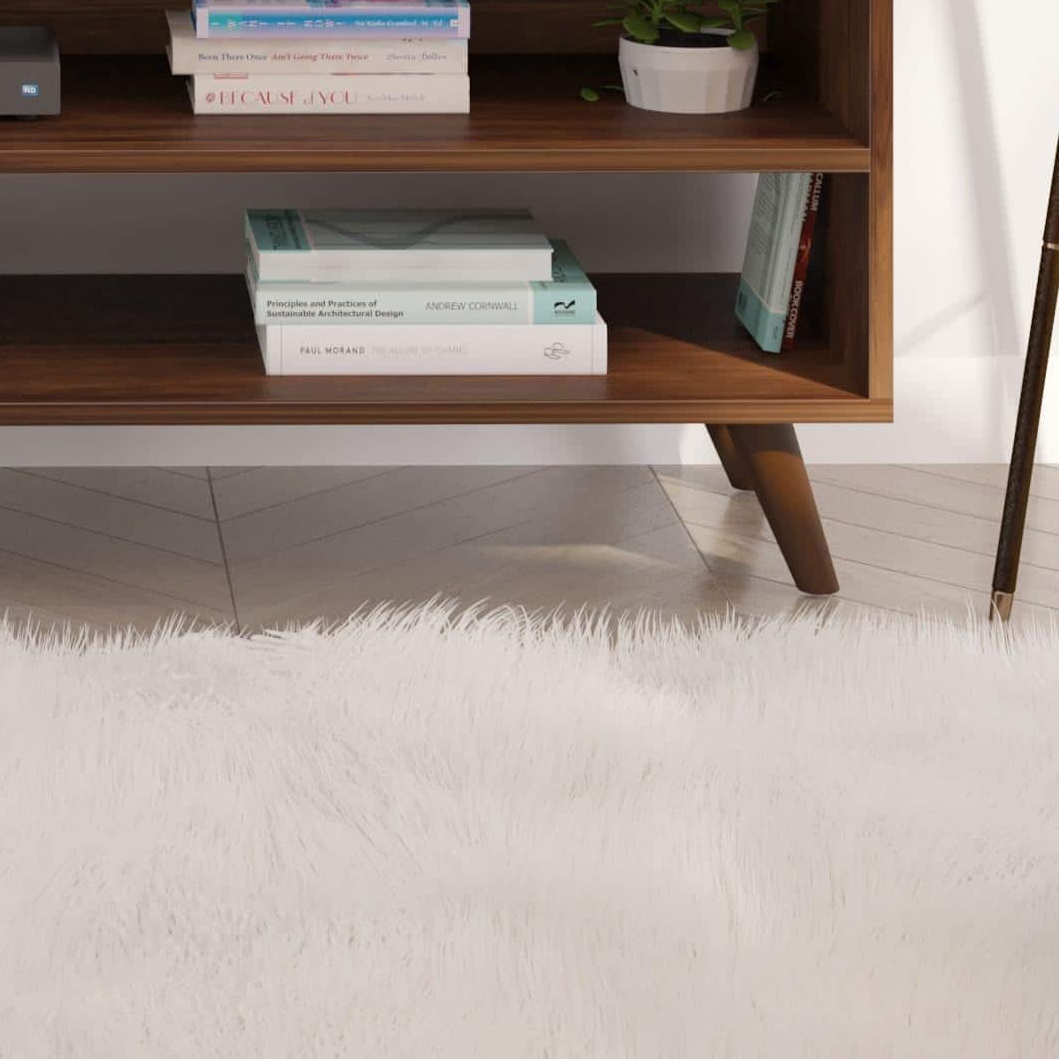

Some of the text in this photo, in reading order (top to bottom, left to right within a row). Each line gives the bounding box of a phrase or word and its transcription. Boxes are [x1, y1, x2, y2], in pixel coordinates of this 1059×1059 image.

[198, 53, 219, 61] Been
[221, 53, 244, 61] There
[246, 53, 268, 61] Once
[293, 53, 319, 63] Going
[317, 91, 357, 105] YOU
[811, 173, 823, 211] CALLUM
[266, 299, 378, 309] Principles and Practices of
[425, 302, 519, 312] ANDREW CORNWALL
[266, 310, 404, 319] Sustainable Architectural Design
[786, 280, 804, 339] BOOK COVER
[299, 346, 366, 355] PAUL MORAND
